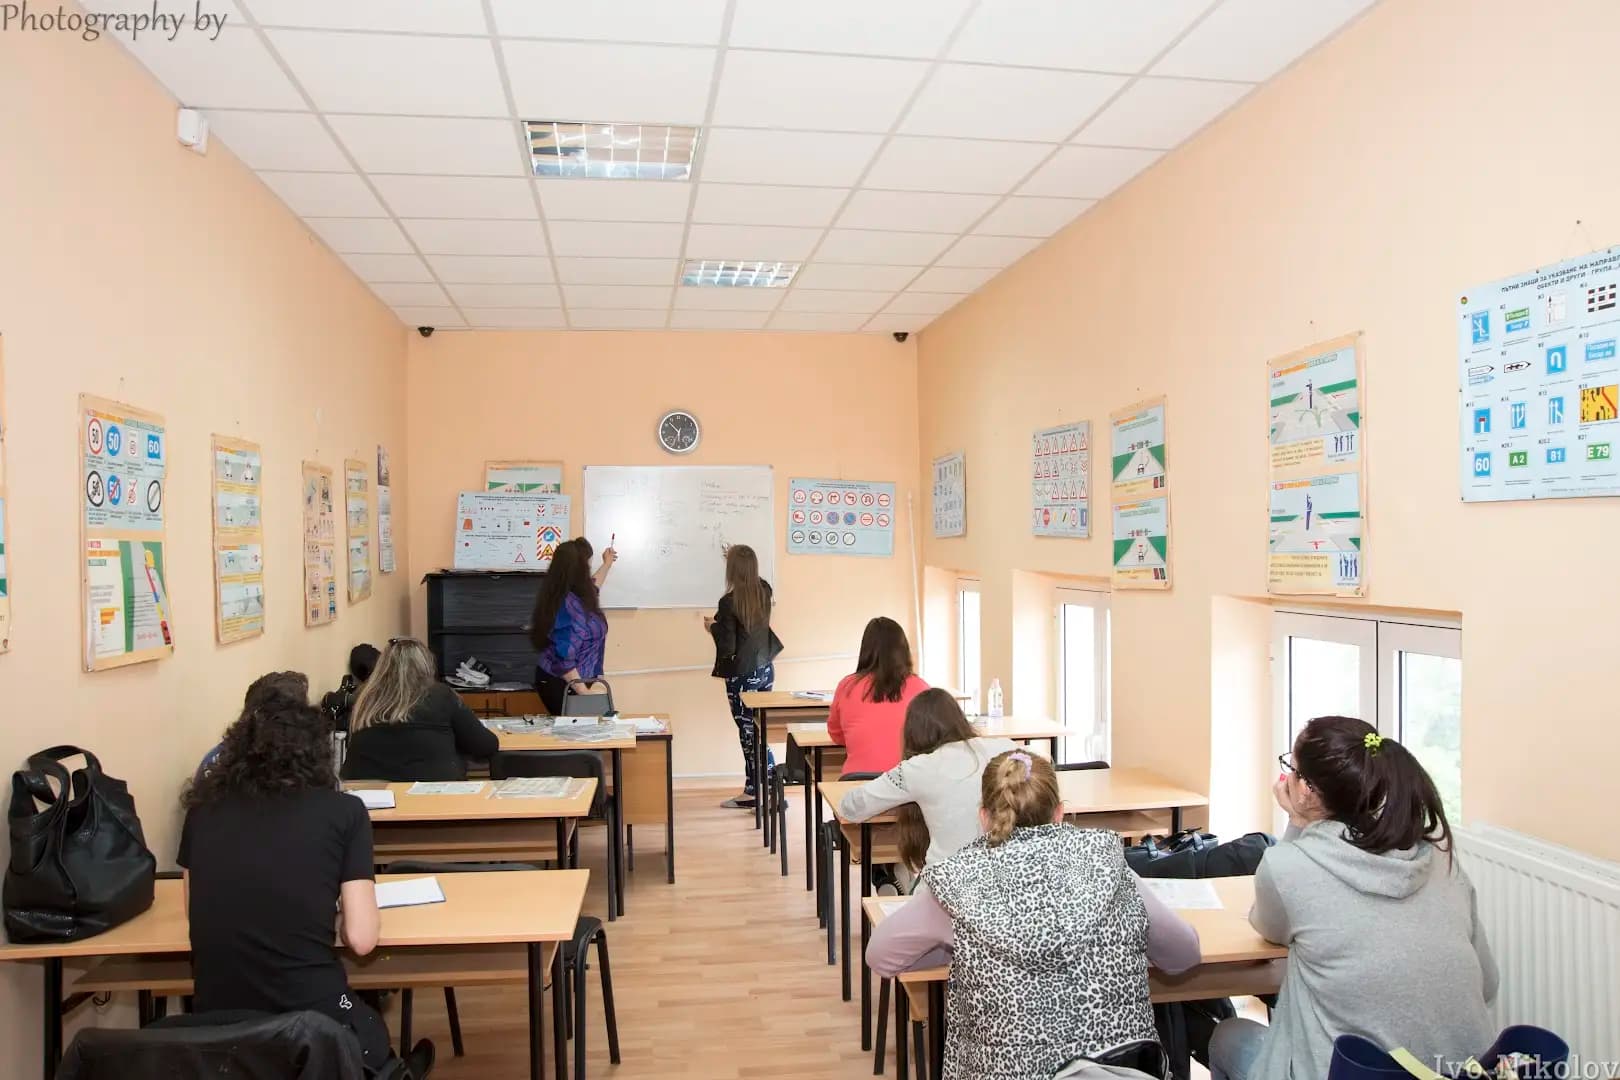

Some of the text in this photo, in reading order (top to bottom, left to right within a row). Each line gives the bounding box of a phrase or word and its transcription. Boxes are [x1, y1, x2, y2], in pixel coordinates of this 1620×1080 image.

[108, 432, 119, 451] 50
[148, 439, 159, 454] 60
[1475, 457, 1490, 472] 60
